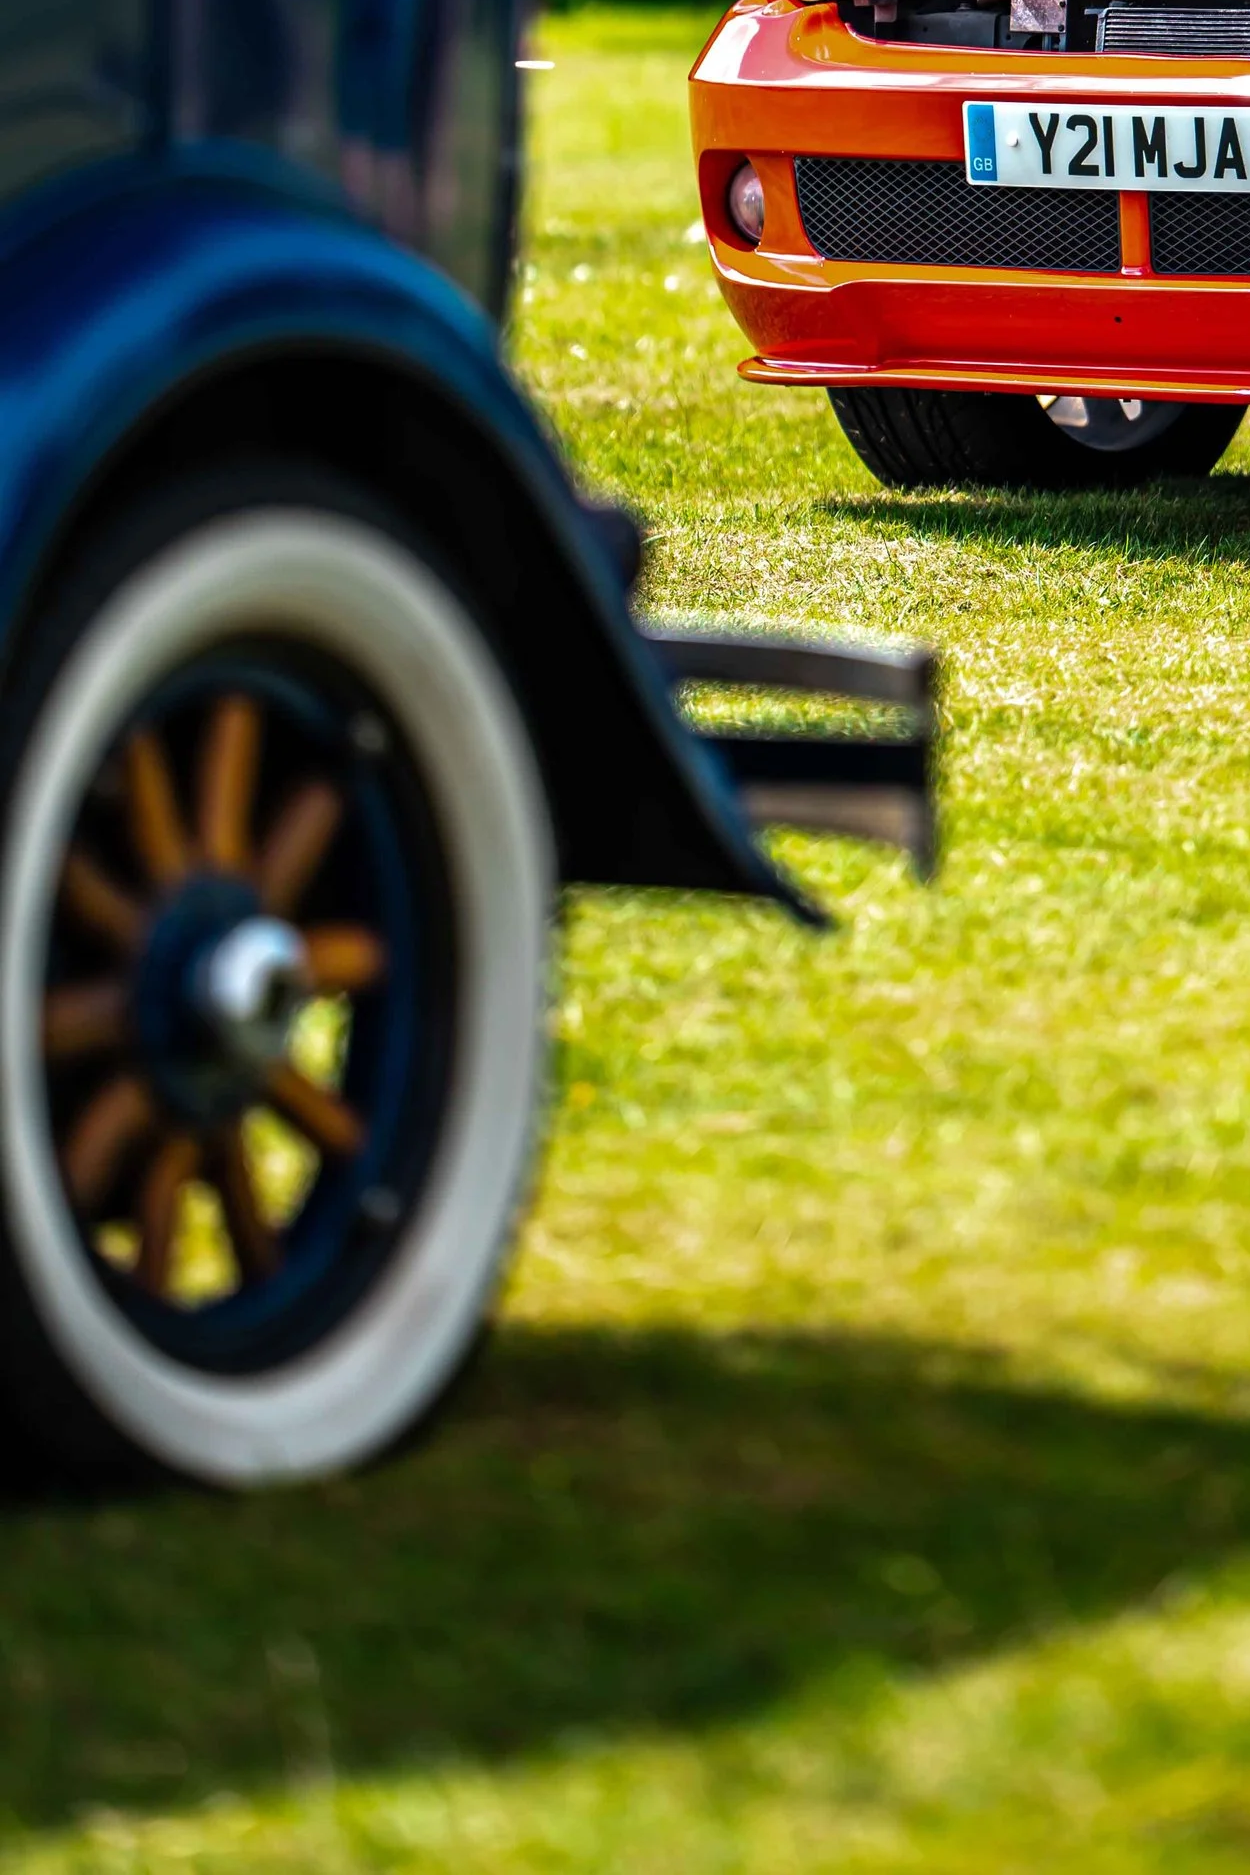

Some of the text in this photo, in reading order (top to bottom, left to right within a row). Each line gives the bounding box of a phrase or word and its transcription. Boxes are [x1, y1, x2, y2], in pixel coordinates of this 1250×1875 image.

[973, 157, 994, 172] GB
[1028, 112, 1249, 181] Y21 MJA
